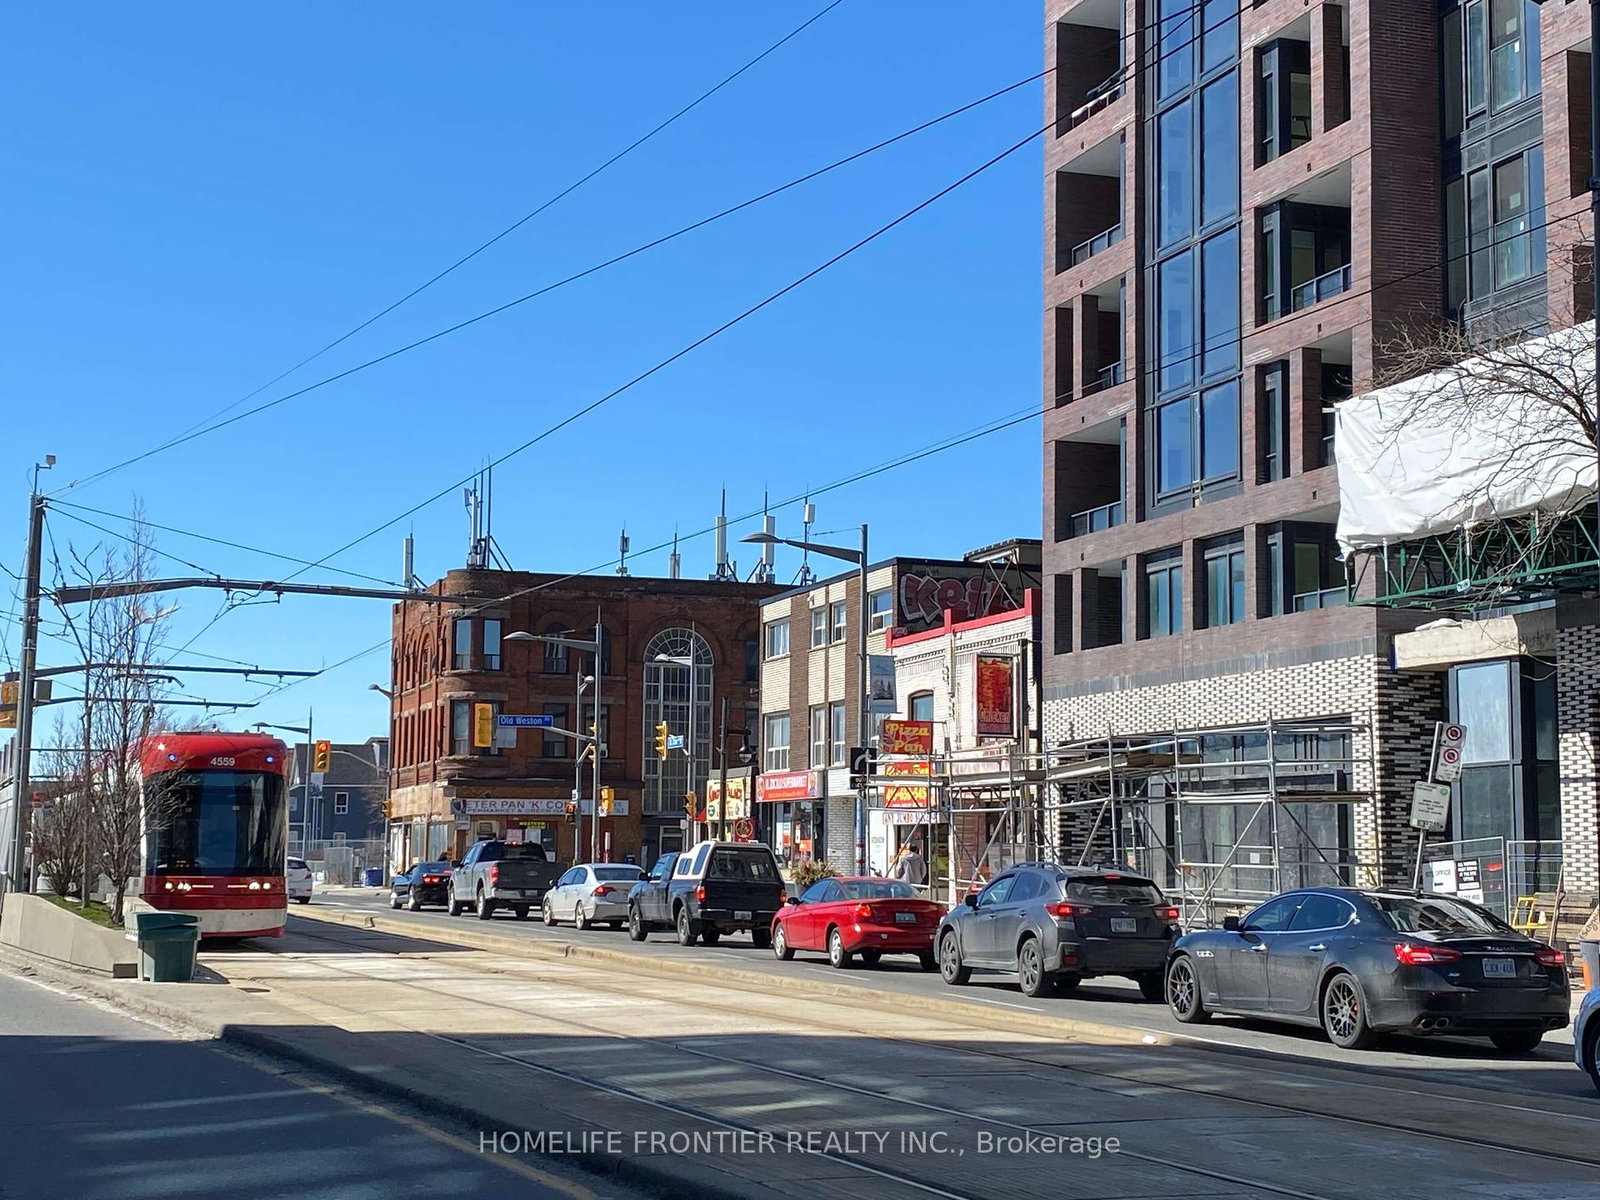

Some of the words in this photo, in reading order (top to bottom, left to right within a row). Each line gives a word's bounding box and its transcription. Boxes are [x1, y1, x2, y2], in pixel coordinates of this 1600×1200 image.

[501, 716, 514, 725] Old
[516, 716, 542, 725] Weston
[886, 723, 930, 736] Pizza
[893, 740, 925, 752] Pan
[210, 757, 236, 766] 4559
[465, 800, 497, 808] ETER
[501, 800, 525, 808] PAN
[529, 800, 542, 808] 'K'
